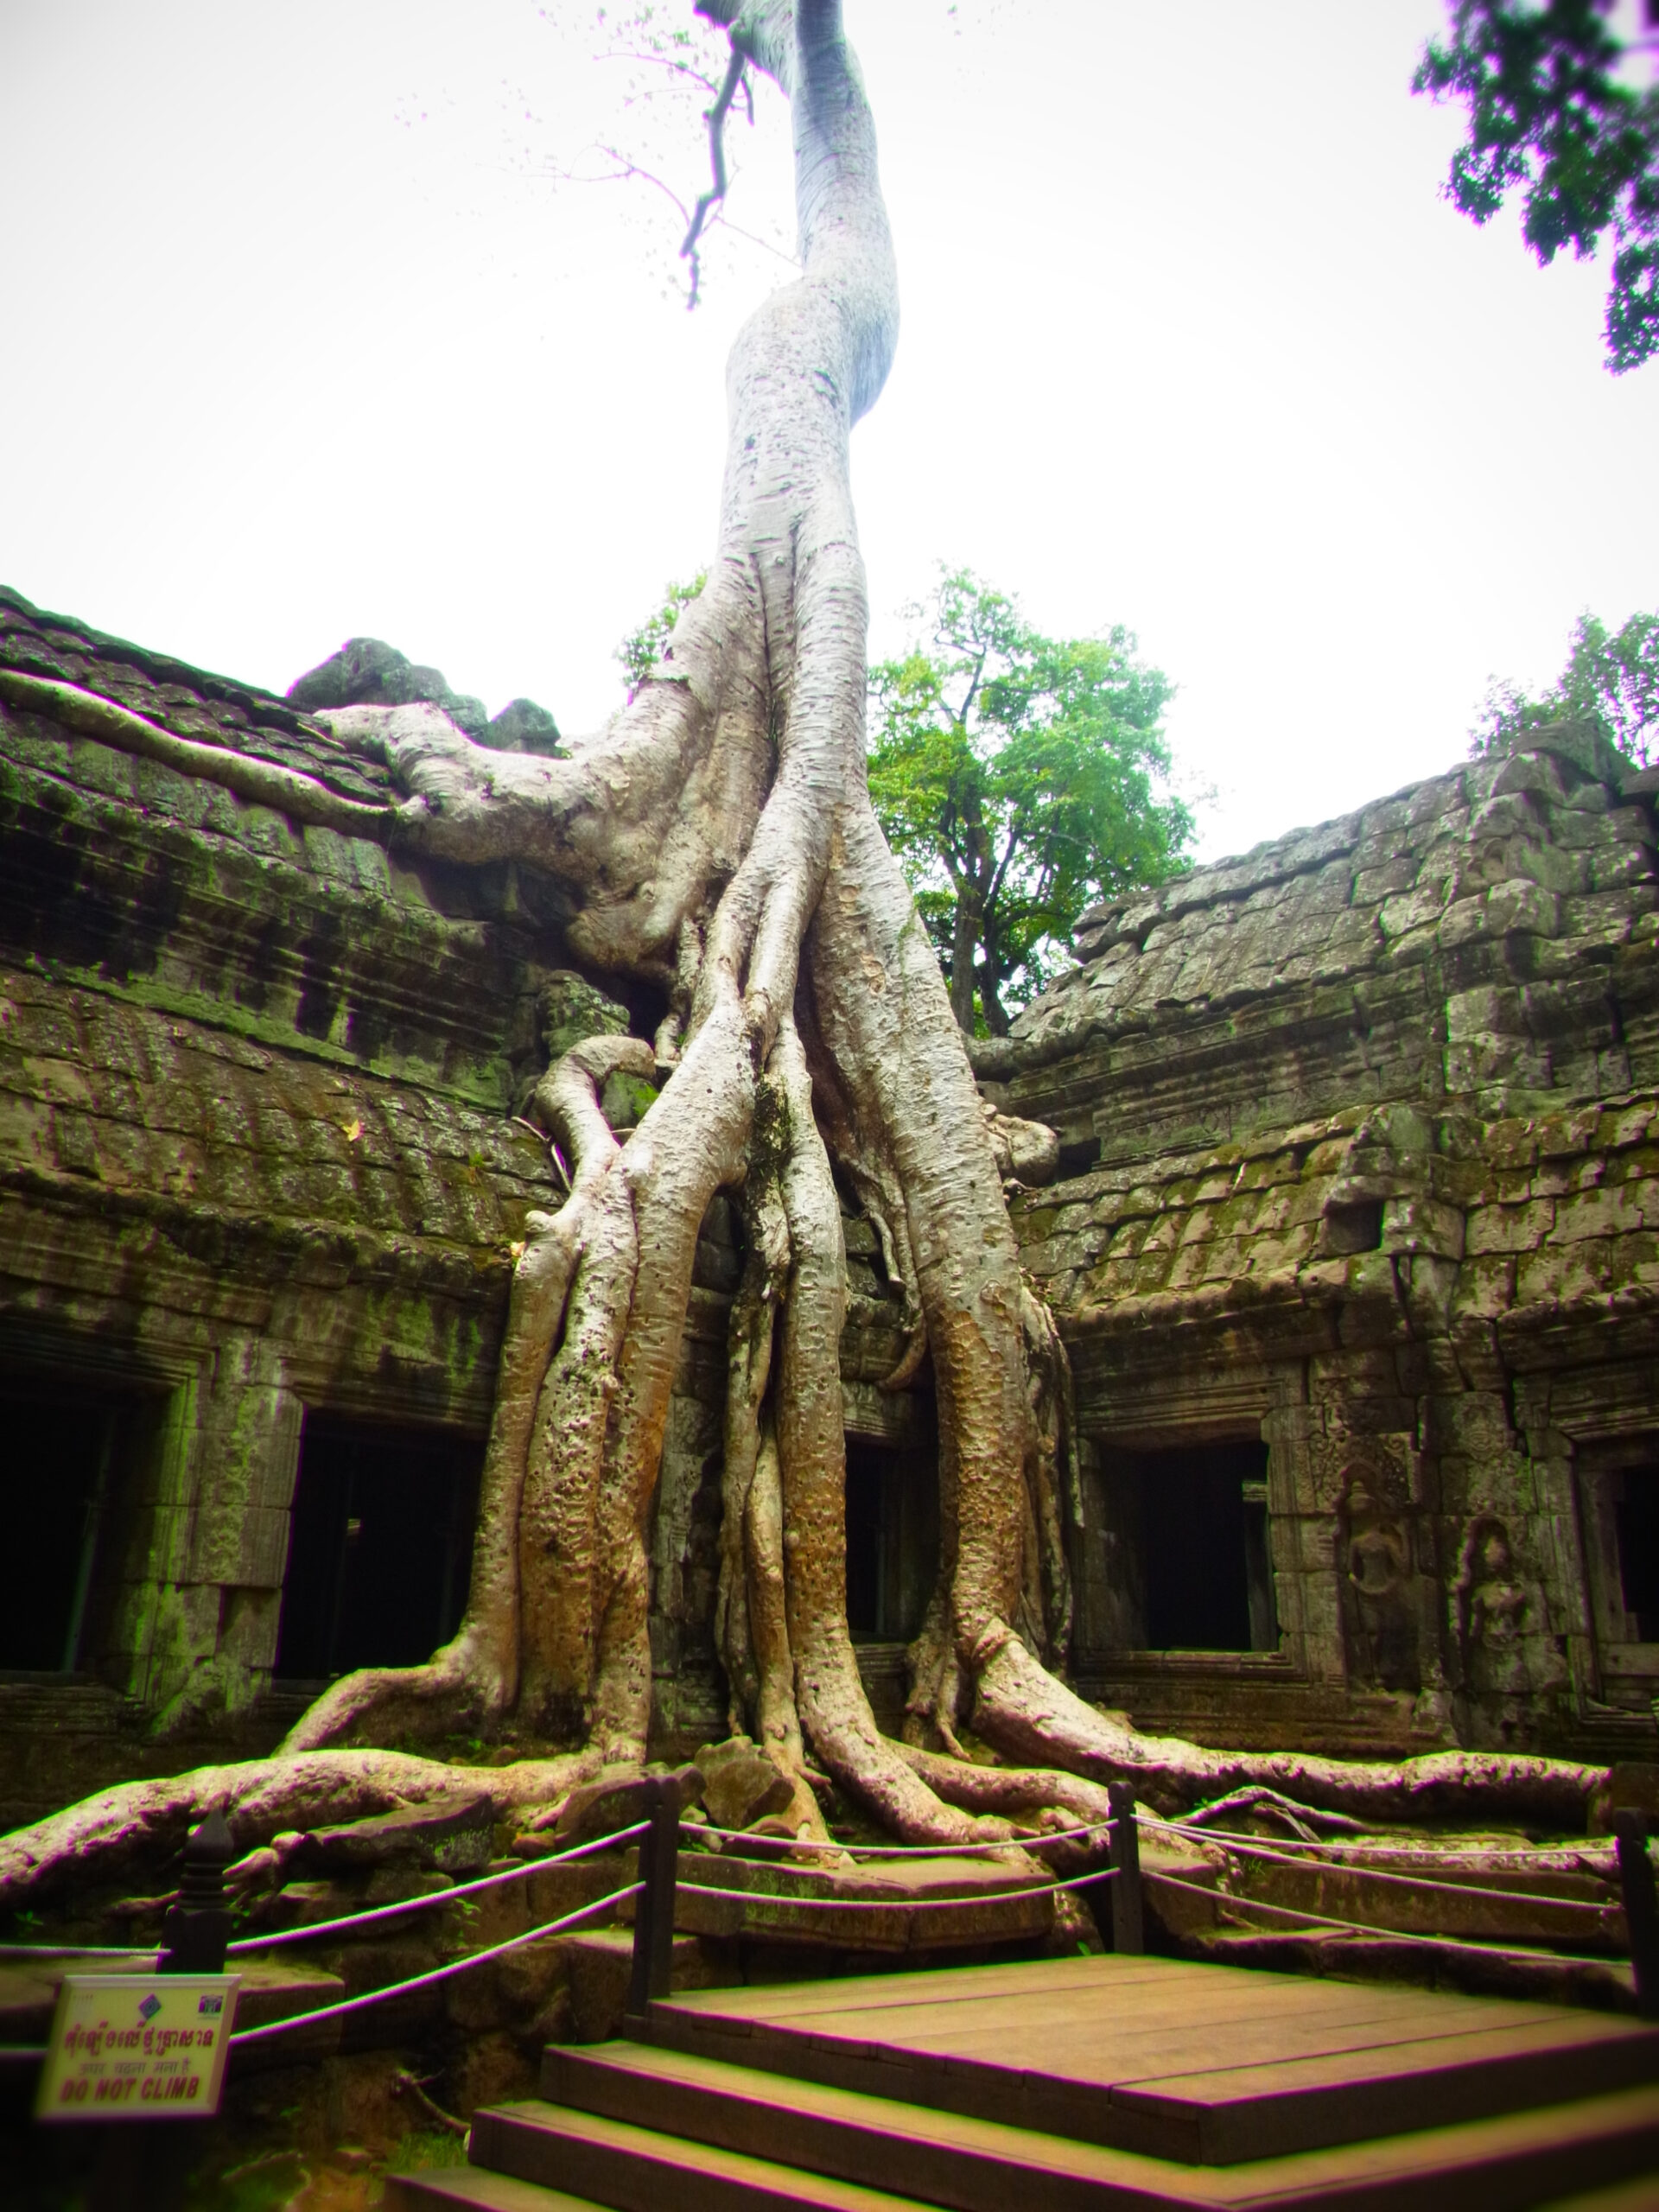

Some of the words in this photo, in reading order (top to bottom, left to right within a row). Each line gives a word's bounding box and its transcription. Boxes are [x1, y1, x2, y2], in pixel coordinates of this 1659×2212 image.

[60, 2077, 88, 2101] DO
[94, 2076, 137, 2101] NOT
[141, 2075, 200, 2100] CLIMB
